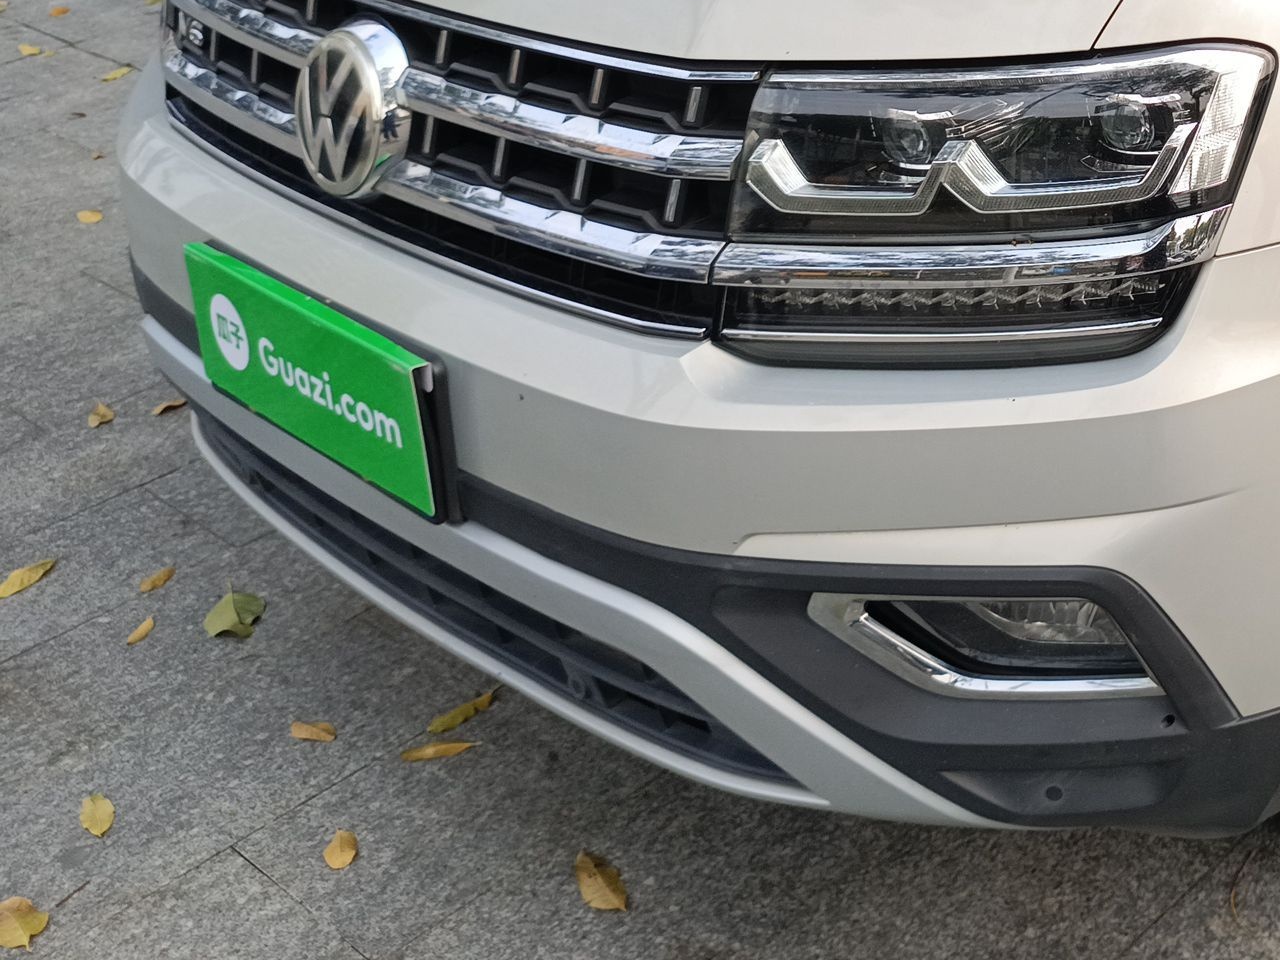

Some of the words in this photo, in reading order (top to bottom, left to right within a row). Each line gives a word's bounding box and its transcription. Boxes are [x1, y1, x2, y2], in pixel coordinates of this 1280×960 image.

[178, 10, 204, 47] V6
[216, 312, 245, 350] 瓜子
[258, 337, 403, 449] Guazi.com
